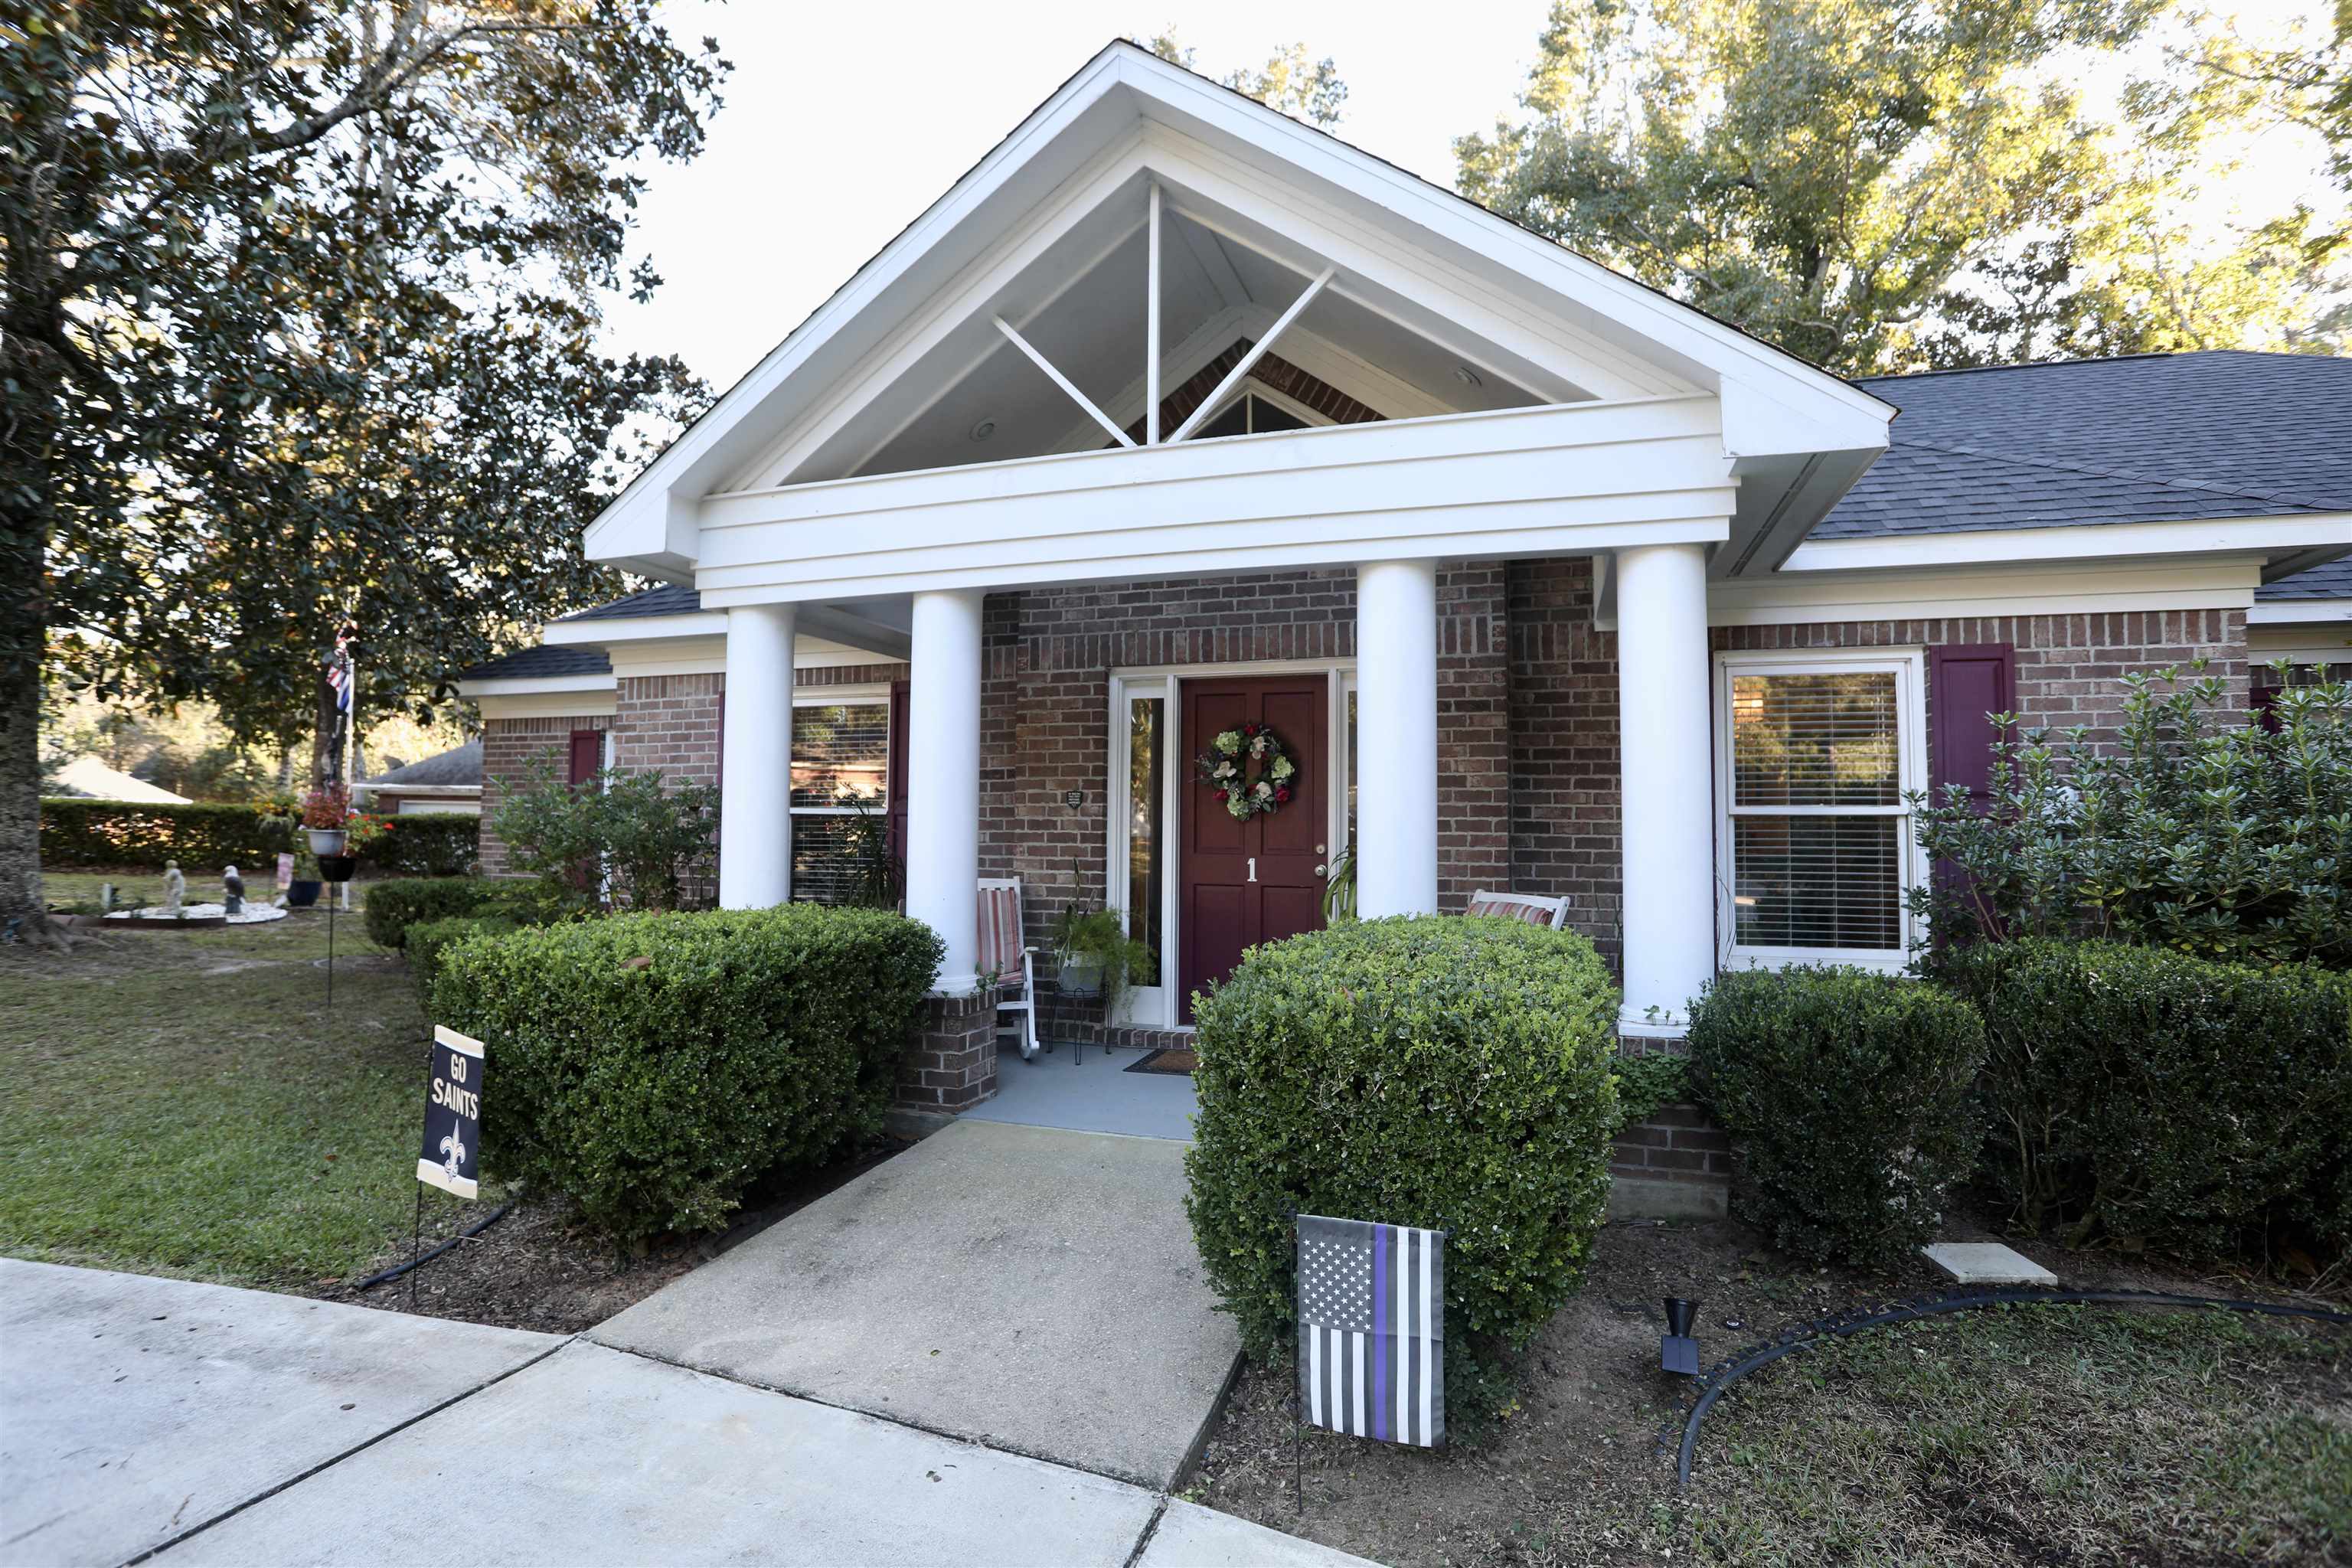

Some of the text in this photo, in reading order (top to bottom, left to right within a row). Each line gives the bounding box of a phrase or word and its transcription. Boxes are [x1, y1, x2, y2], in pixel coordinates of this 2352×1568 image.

[1247, 858, 1257, 882] 1
[451, 1054, 466, 1083] GO
[432, 1078, 478, 1120] SAINTS
